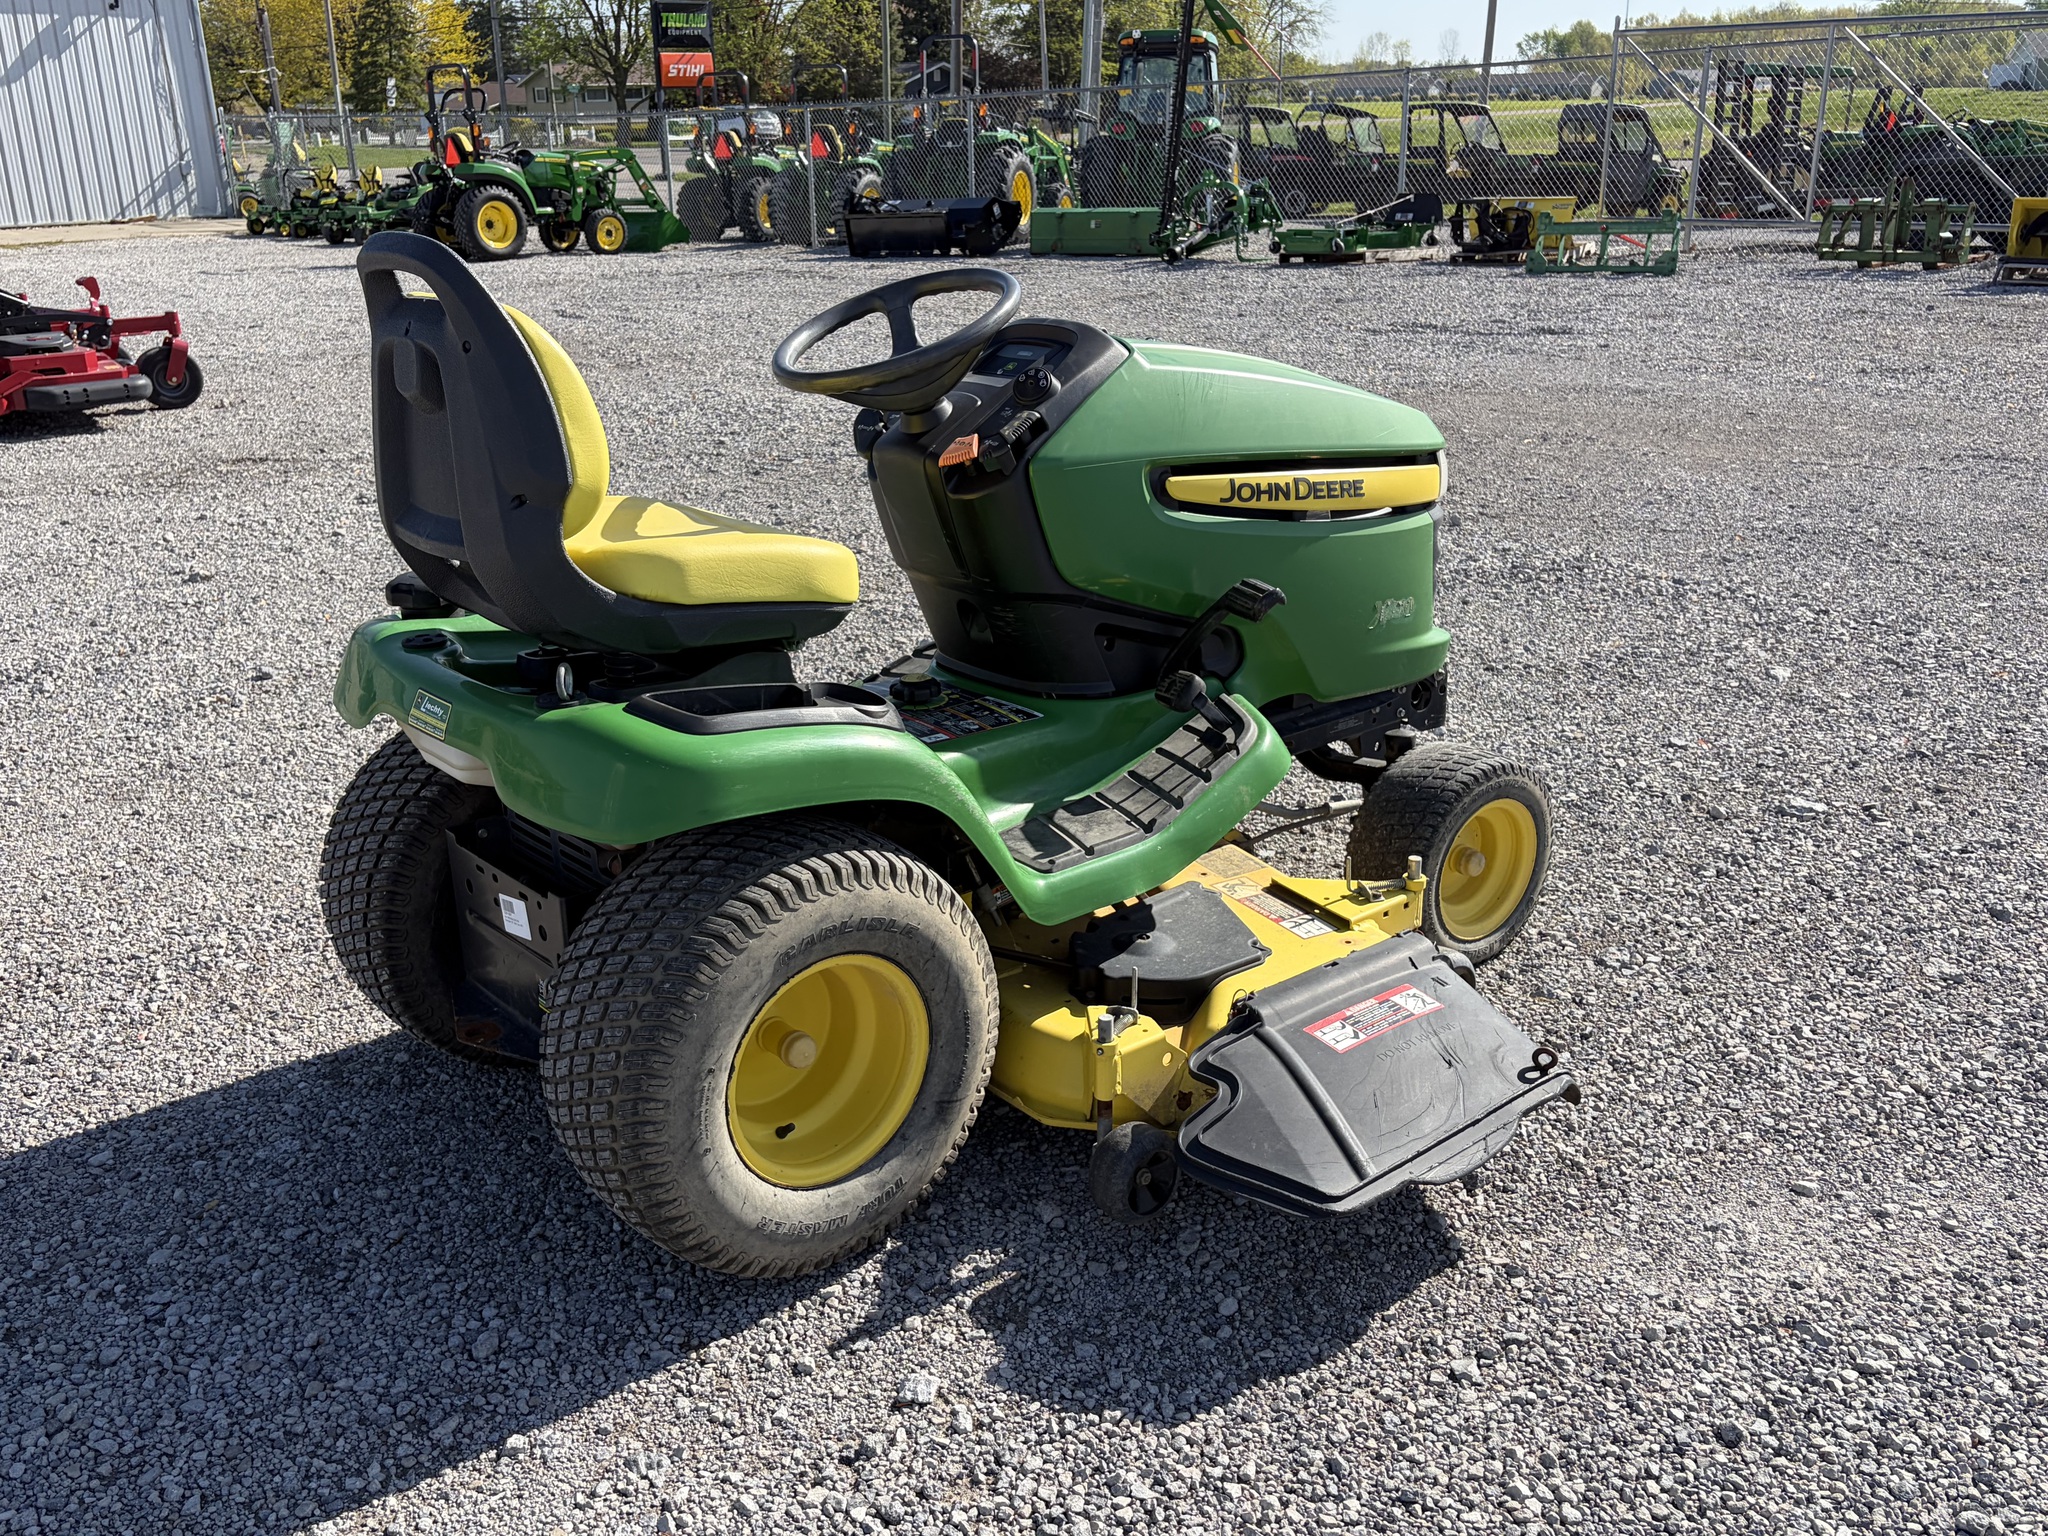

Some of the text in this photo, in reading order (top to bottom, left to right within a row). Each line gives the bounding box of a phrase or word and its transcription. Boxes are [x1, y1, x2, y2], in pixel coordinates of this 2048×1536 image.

[660, 12, 708, 28] TRULAND
[667, 64, 705, 77] STIHL
[1219, 477, 1366, 503] JOHN DEERE
[420, 696, 445, 717] Liechty
[778, 915, 921, 968] CARLISLE
[1376, 1049, 1395, 1062] DO
[1394, 1039, 1417, 1054] NOT
[757, 1175, 908, 1238] TURF MASTER
